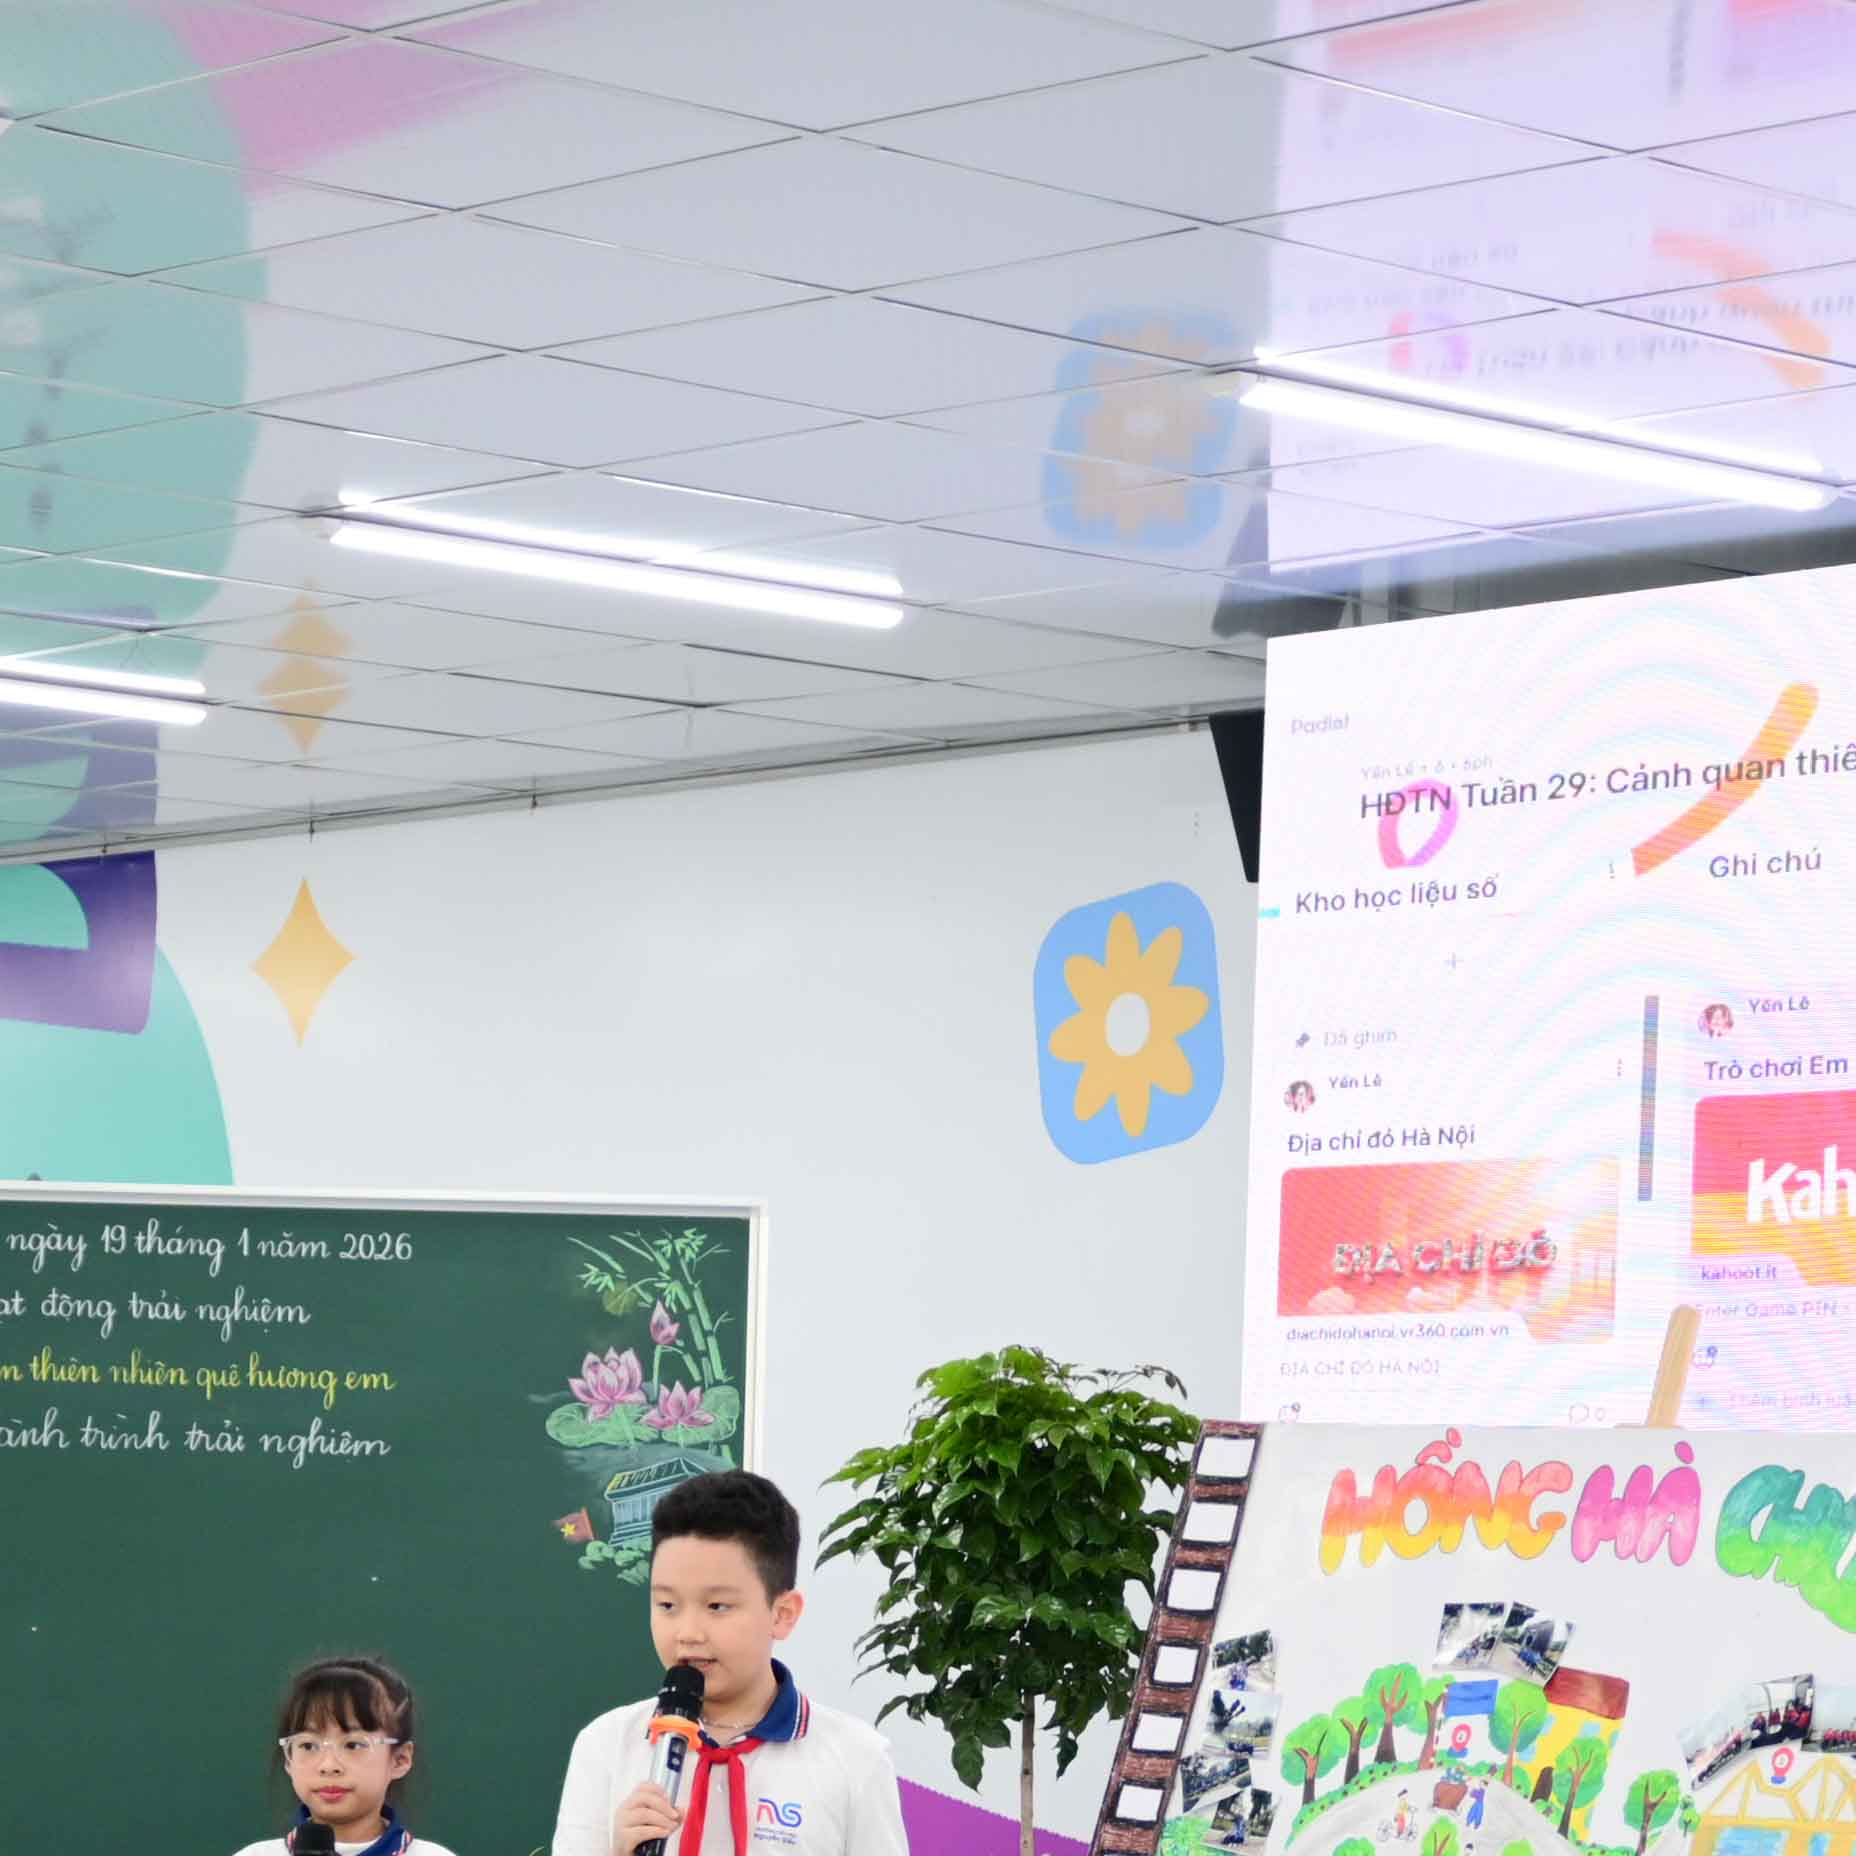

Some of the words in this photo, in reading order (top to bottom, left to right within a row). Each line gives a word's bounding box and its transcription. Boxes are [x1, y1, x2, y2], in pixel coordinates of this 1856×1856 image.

[1360, 786, 1452, 818] HĐTN
[1462, 777, 1537, 808] Tuần
[1548, 772, 1597, 800] 29:
[1607, 762, 1691, 794] Cảnh
[1702, 757, 1785, 790] quan
[1709, 853, 1757, 878] Ghi
[1767, 844, 1822, 874] chú
[1296, 891, 1345, 913] Kho
[1354, 887, 1401, 911] học
[1410, 882, 1457, 908] liệu
[1466, 873, 1499, 899] số
[1704, 1059, 1743, 1081] Trò
[1749, 1056, 1802, 1079] chơi
[1809, 1055, 1848, 1075] Em
[1288, 1133, 1322, 1156] Địa
[1329, 1129, 1362, 1150] chỉ
[1367, 1129, 1394, 1149] đỏ
[1401, 1127, 1431, 1146] Hà
[1438, 1124, 1475, 1149] Nội
[6, 1221, 88, 1273] ngày
[101, 1224, 127, 1254] 19
[134, 1219, 226, 1276] tháng
[238, 1228, 250, 1257] 1
[256, 1230, 332, 1260] năm
[339, 1232, 413, 1261] 2026
[40, 1284, 116, 1338] động
[128, 1288, 185, 1322] trải
[194, 1285, 311, 1342] nghiệm
[28, 1348, 101, 1384] thiên
[108, 1349, 189, 1387] nhiên
[195, 1363, 242, 1400] quê
[248, 1353, 338, 1409] hương
[344, 1371, 396, 1391] em
[81, 1413, 170, 1450] trình
[184, 1418, 245, 1455] trải
[1319, 1426, 1573, 1576] HỒNG
[1570, 1440, 1701, 1566] HÀ
